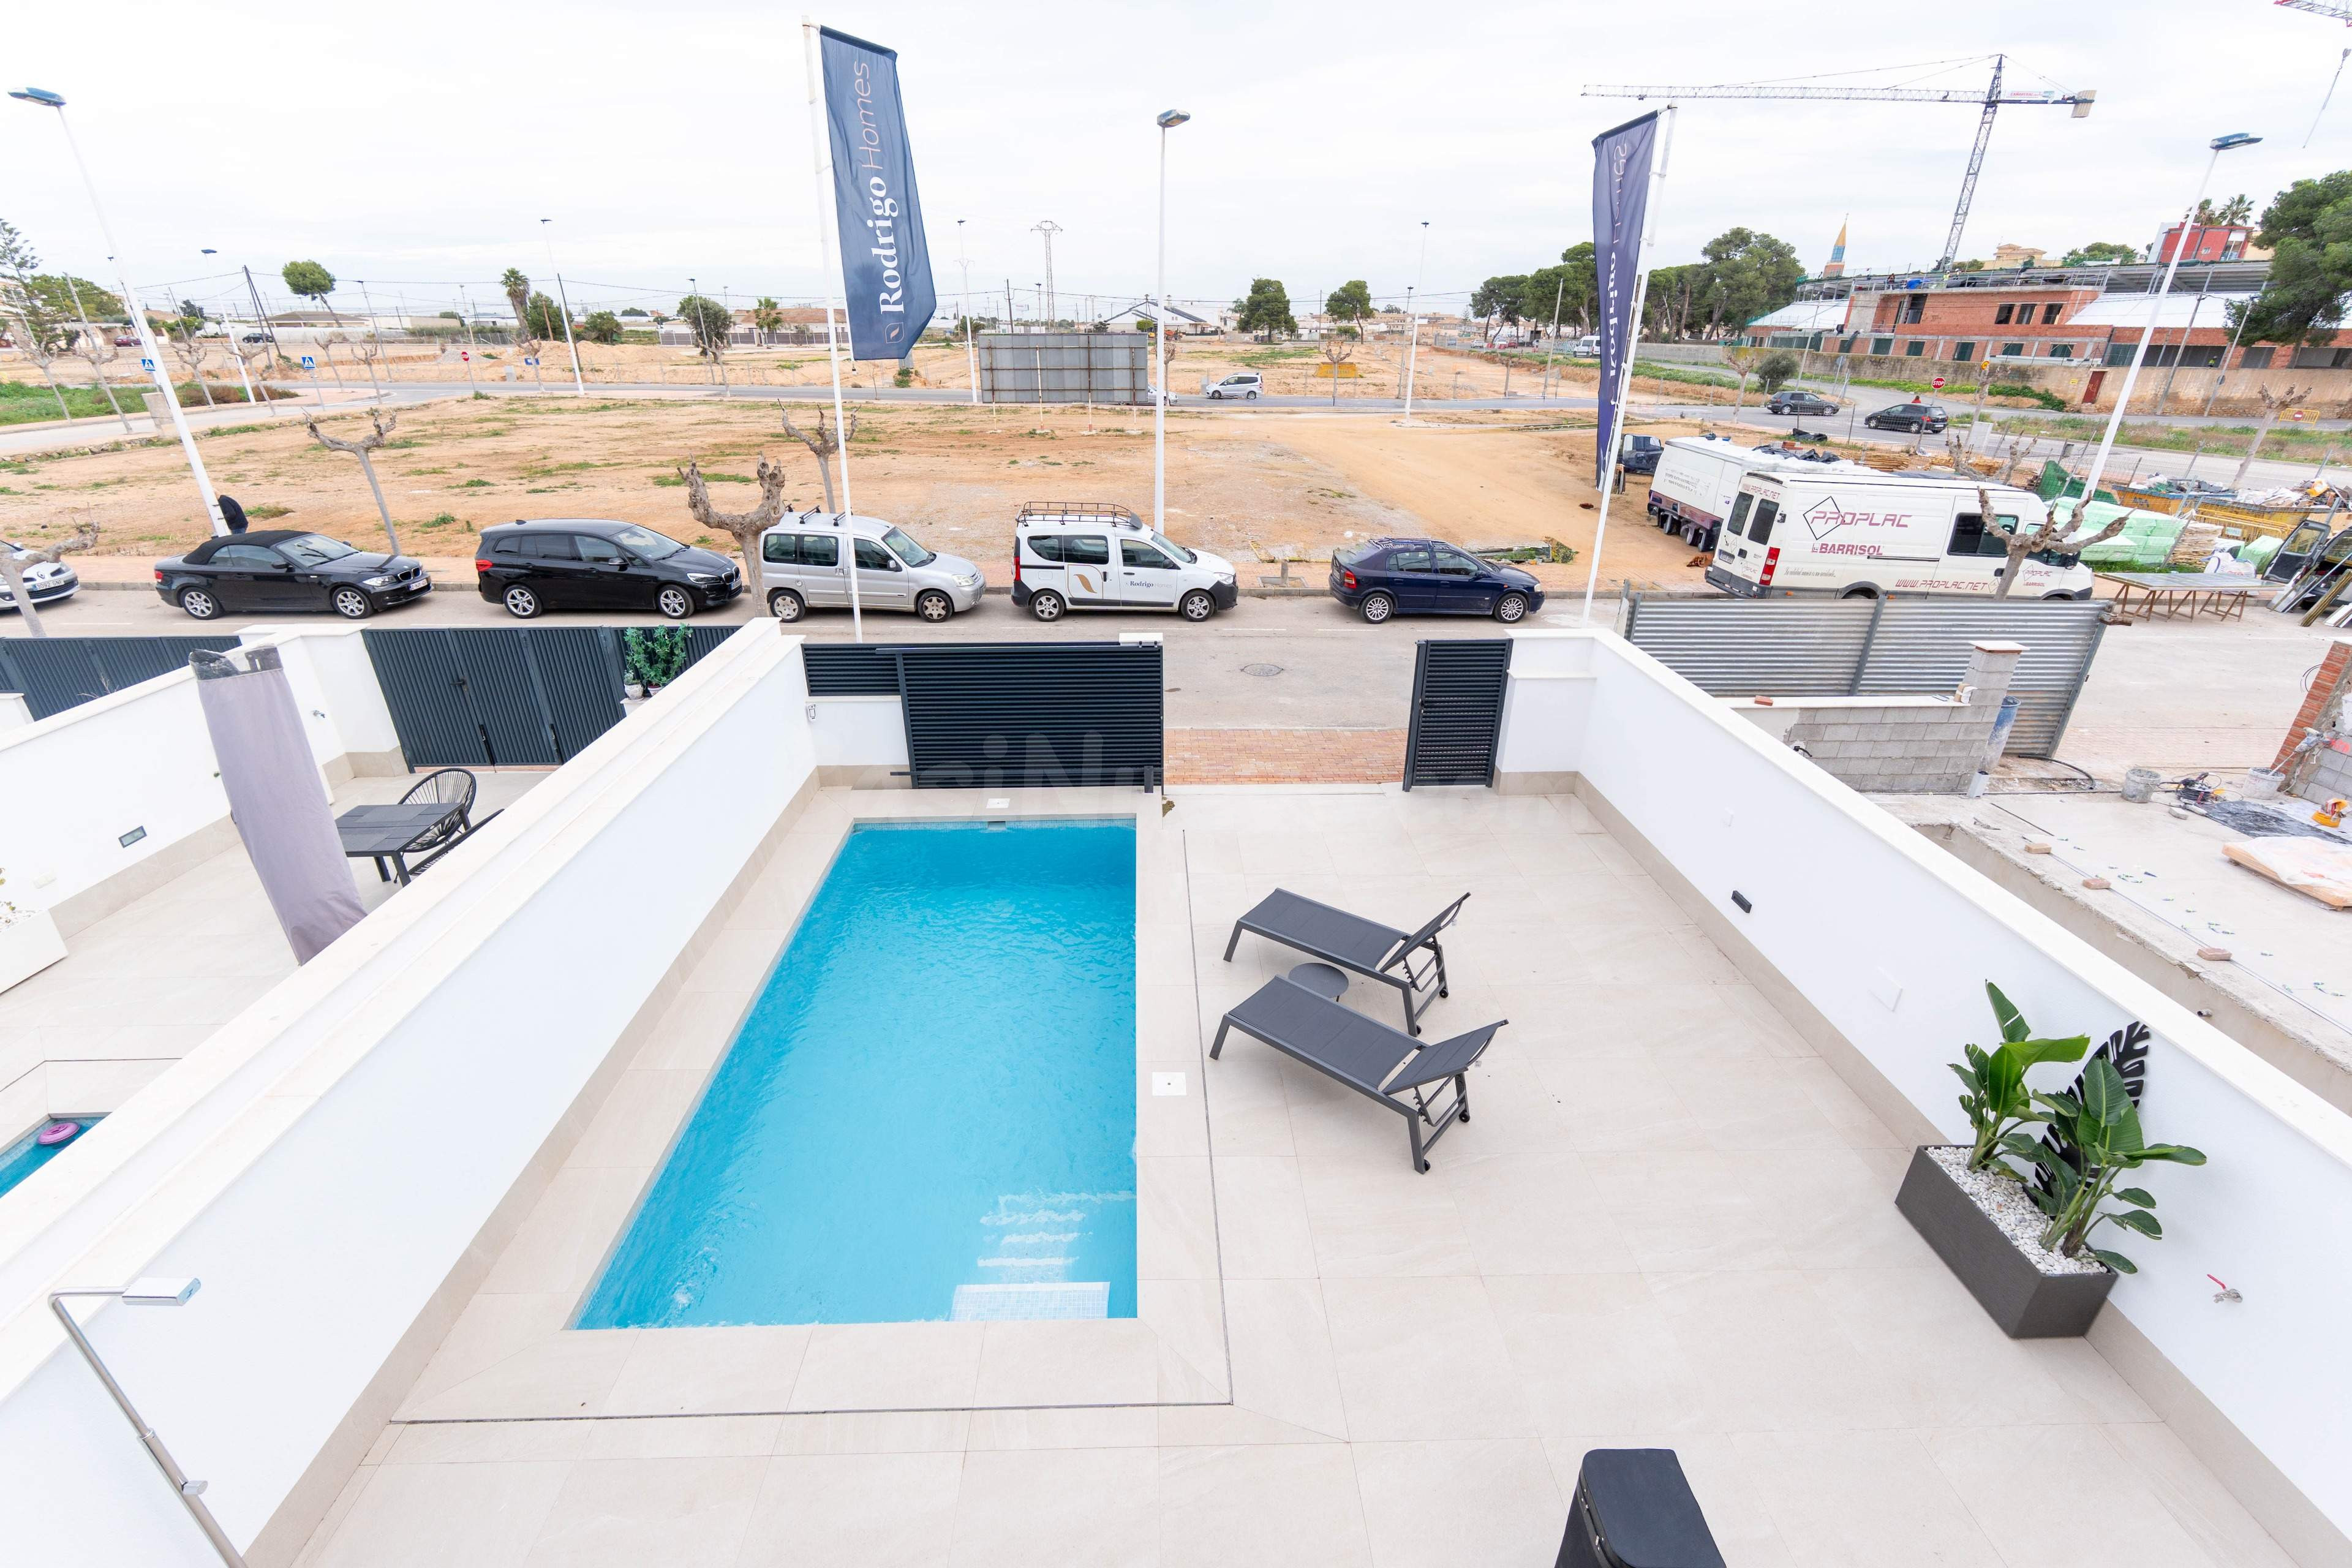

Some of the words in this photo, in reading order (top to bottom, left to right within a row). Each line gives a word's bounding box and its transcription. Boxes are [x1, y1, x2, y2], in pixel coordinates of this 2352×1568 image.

[853, 62, 883, 170] Homes
[866, 176, 905, 315] Rodrigo
[1811, 510, 1912, 528] PROPLAC
[1819, 543, 1883, 555] BARRISOL
